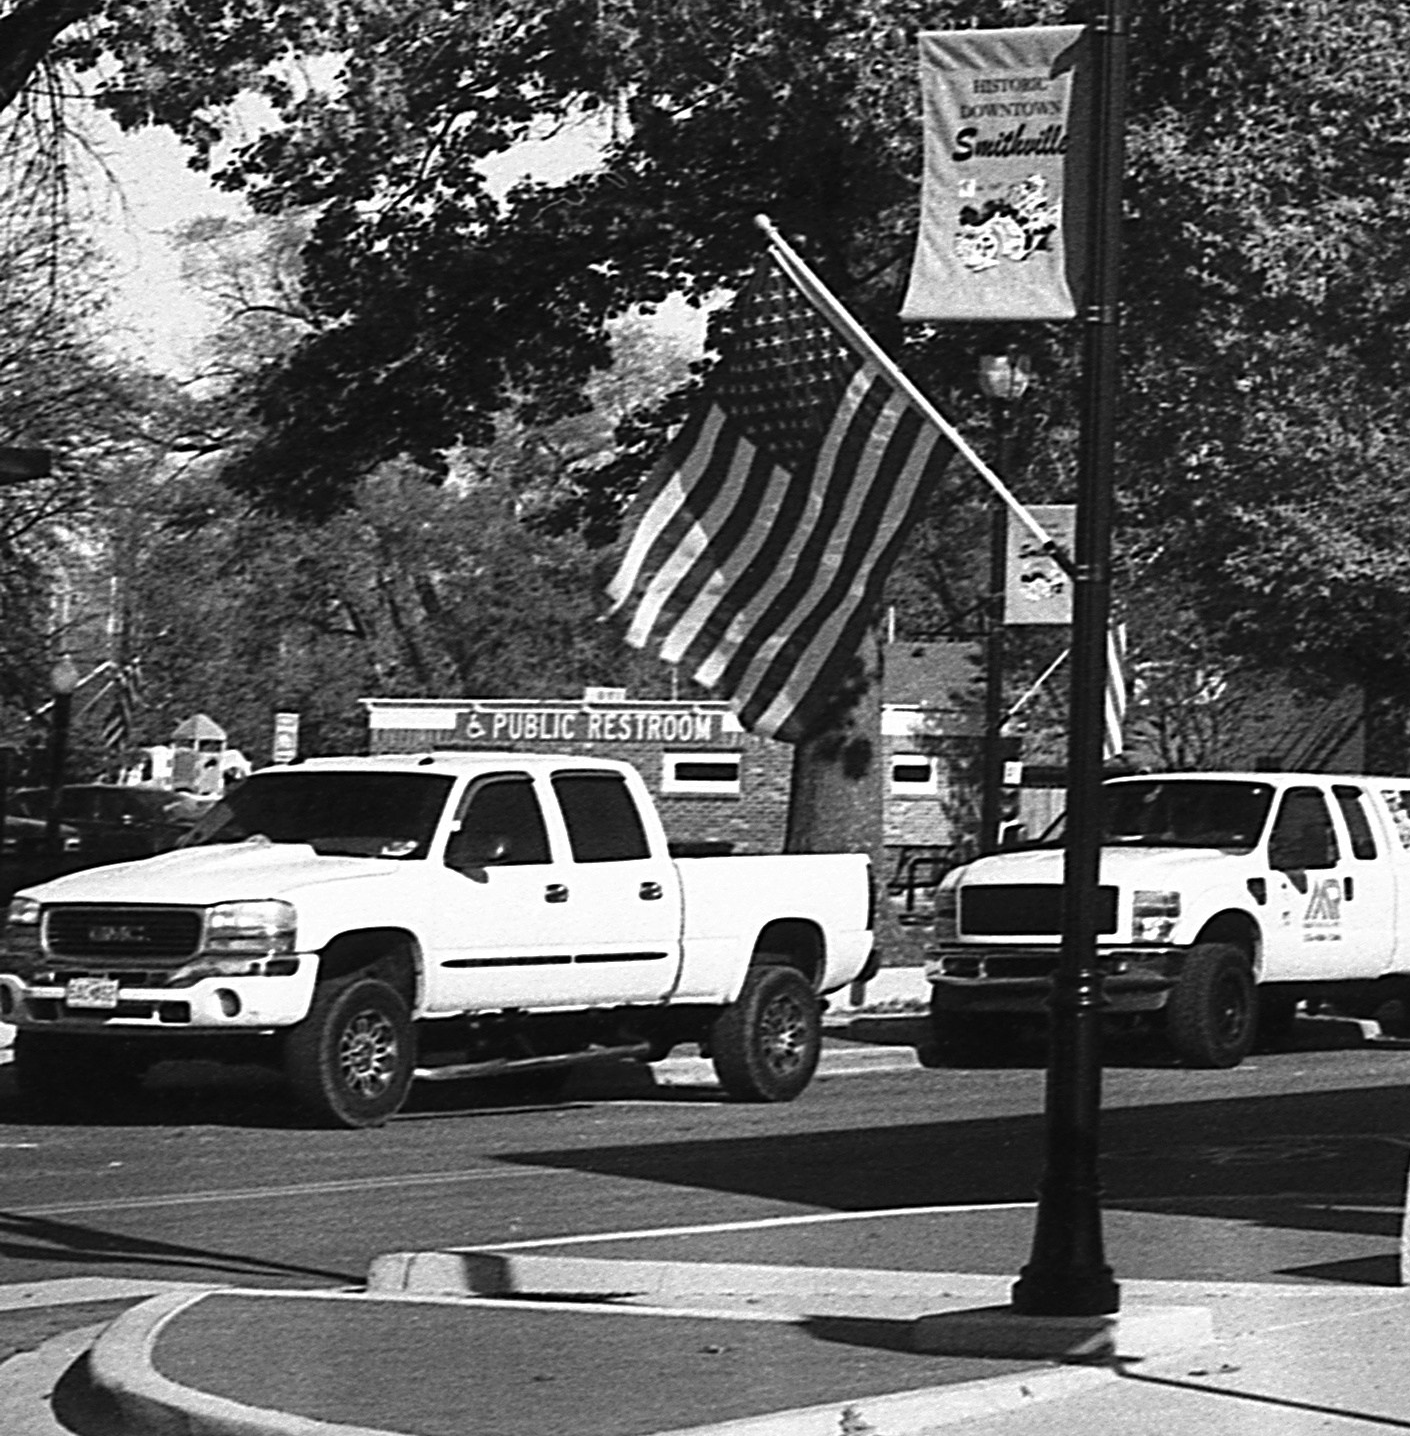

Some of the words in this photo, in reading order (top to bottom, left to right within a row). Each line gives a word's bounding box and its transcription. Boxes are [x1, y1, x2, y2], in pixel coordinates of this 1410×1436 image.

[973, 76, 1048, 94] HISTORIC
[960, 100, 1062, 119] DOWNTOWN
[951, 122, 1070, 162] Smithville
[492, 713, 575, 740] PUBLIC
[587, 713, 712, 741] RESTROOM
